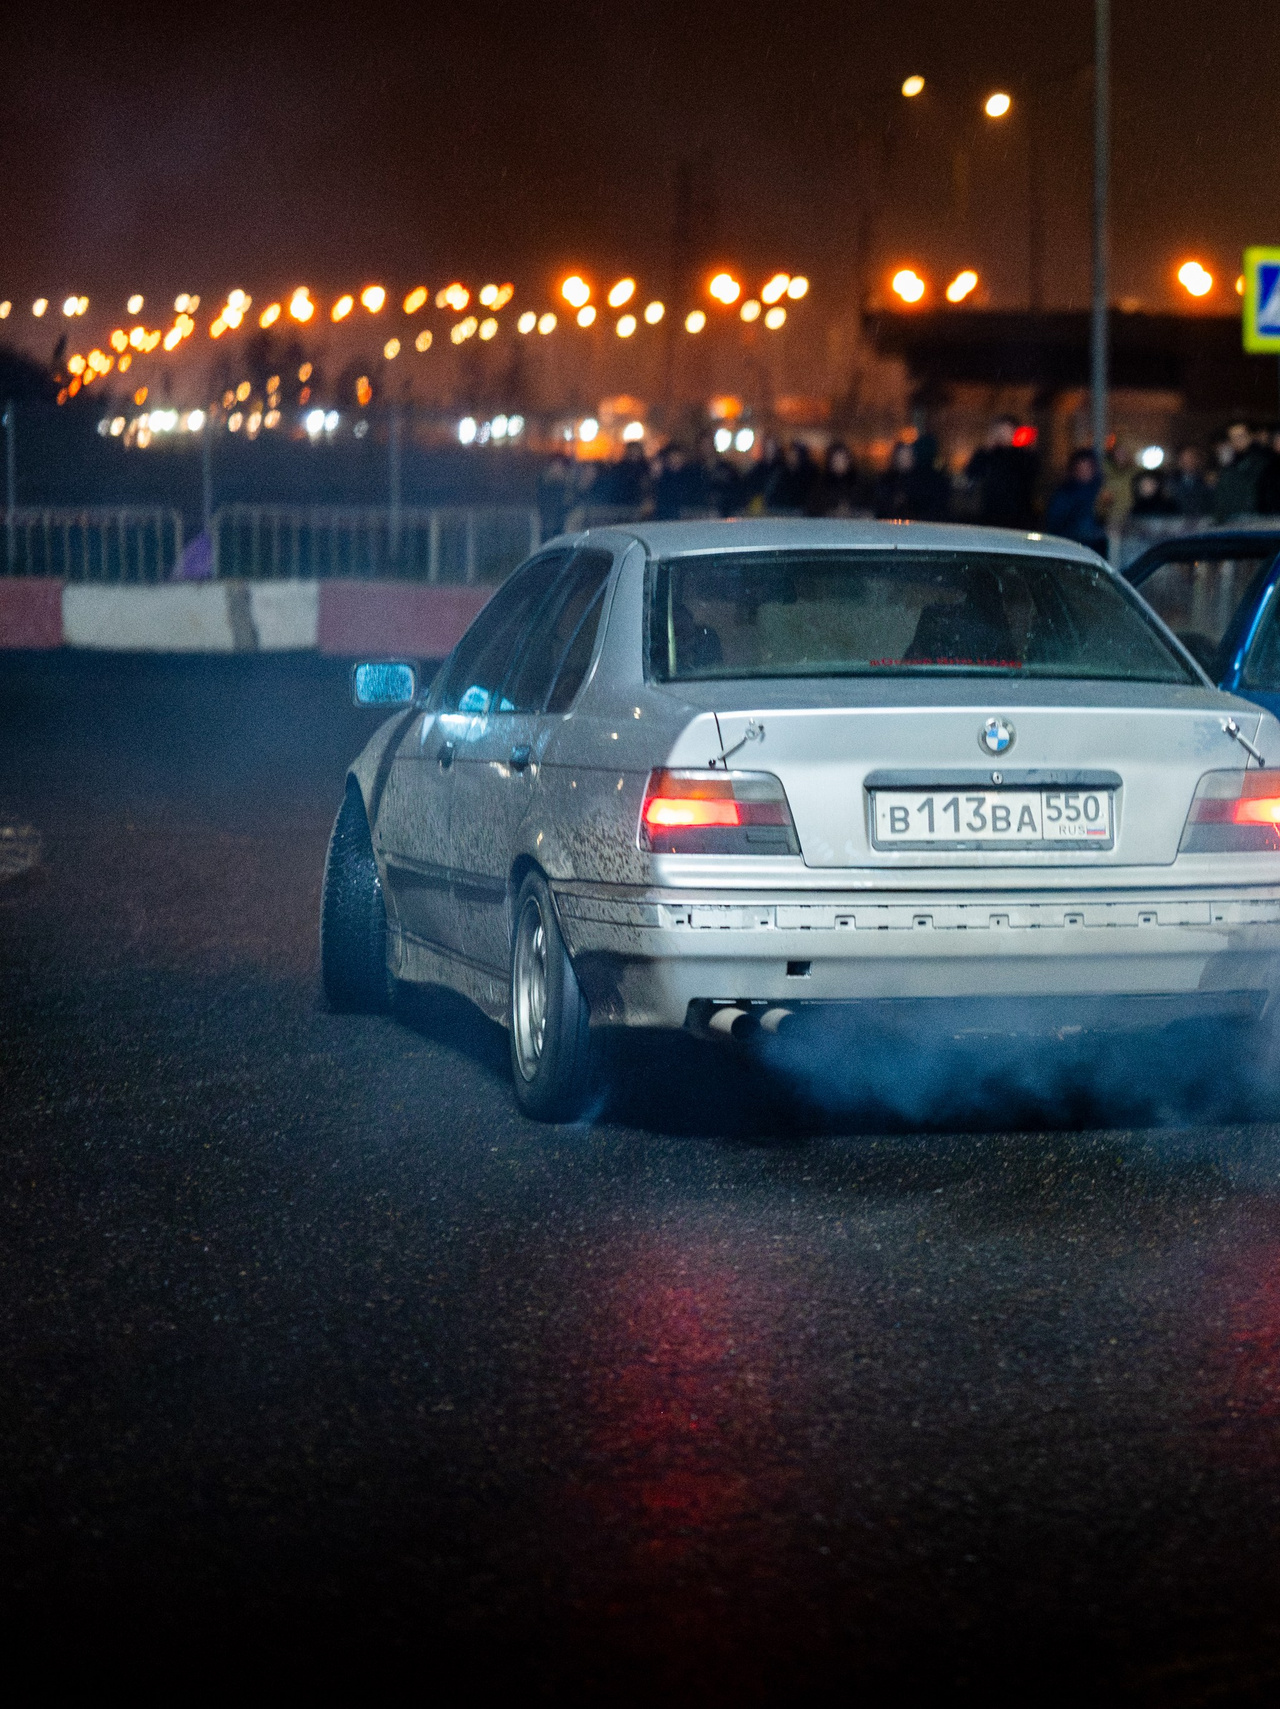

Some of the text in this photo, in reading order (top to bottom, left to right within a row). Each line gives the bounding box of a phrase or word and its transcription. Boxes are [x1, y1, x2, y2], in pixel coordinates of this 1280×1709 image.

[889, 791, 1100, 834] В113ВА 550
[1058, 824, 1086, 836] RUS
